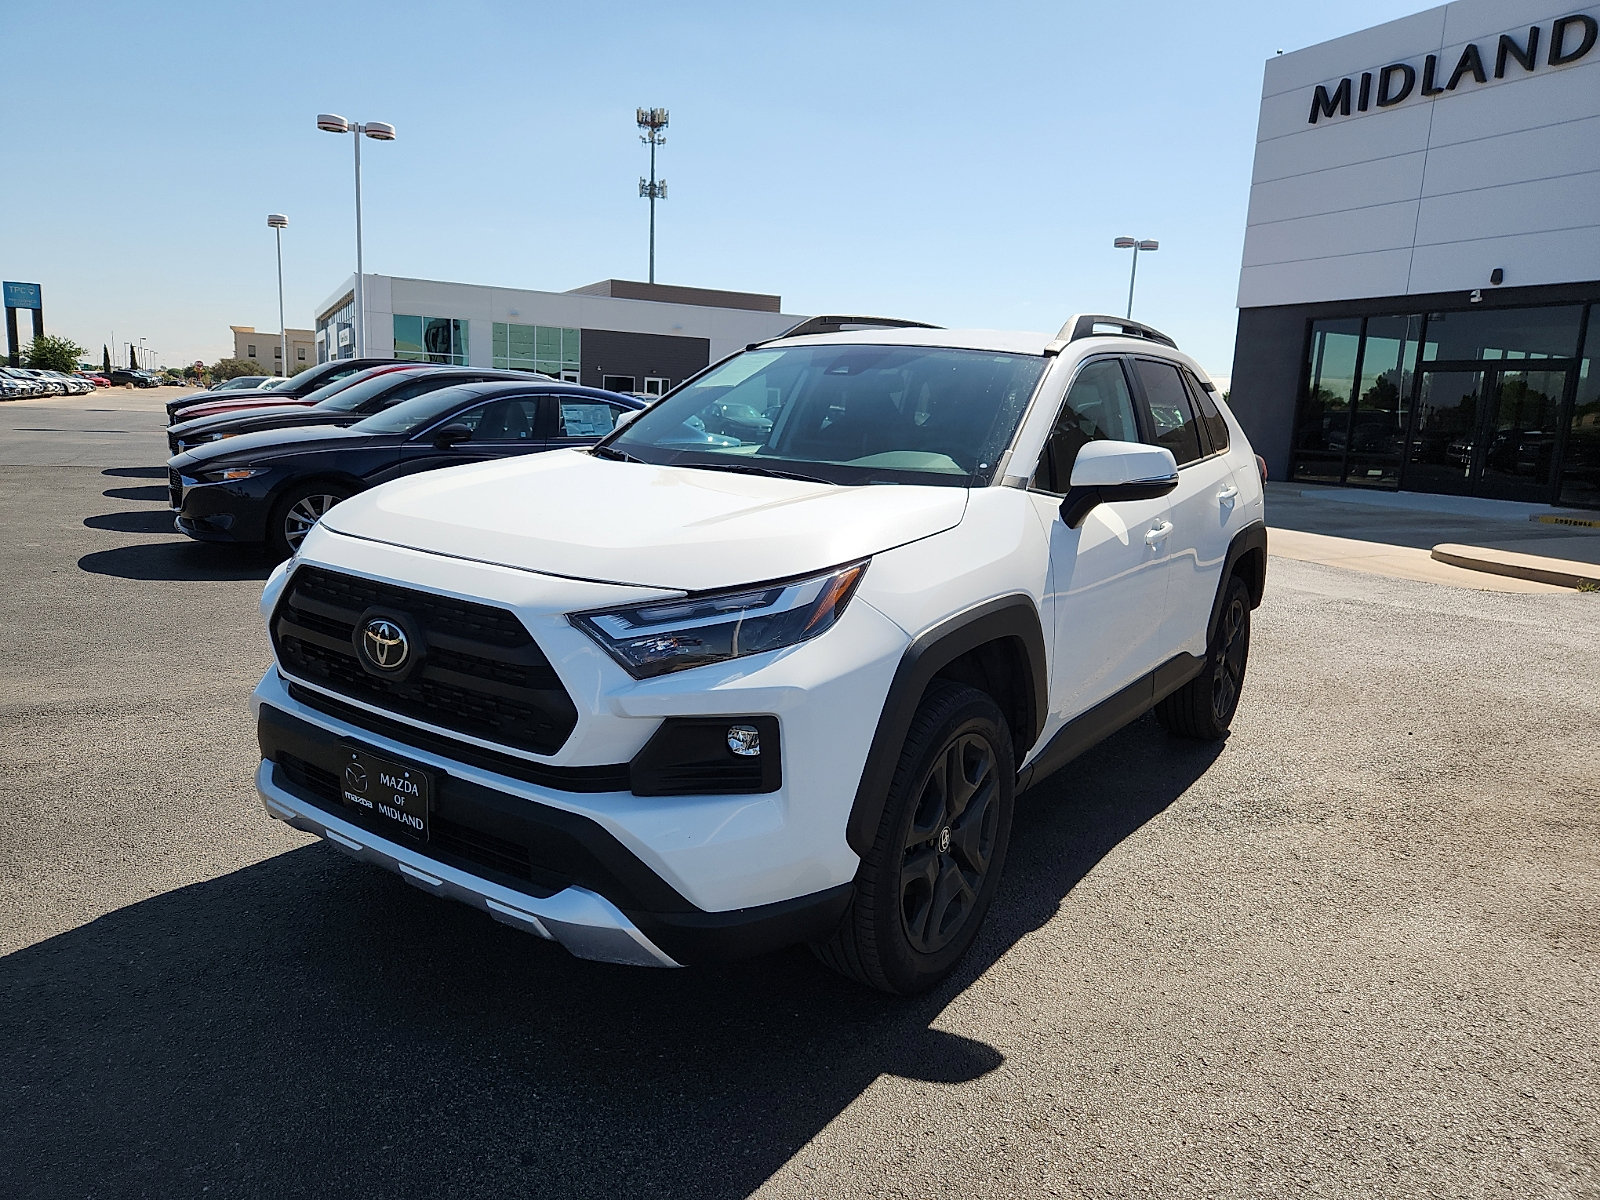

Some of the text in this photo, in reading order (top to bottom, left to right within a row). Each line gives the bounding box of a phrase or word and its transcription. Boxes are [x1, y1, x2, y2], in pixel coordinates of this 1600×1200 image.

[1308, 14, 1599, 124] MIDLAND
[380, 772, 419, 797] MAZDA
[344, 790, 373, 809] mazda
[393, 794, 406, 806] OF
[378, 802, 424, 830] MIDLAND
